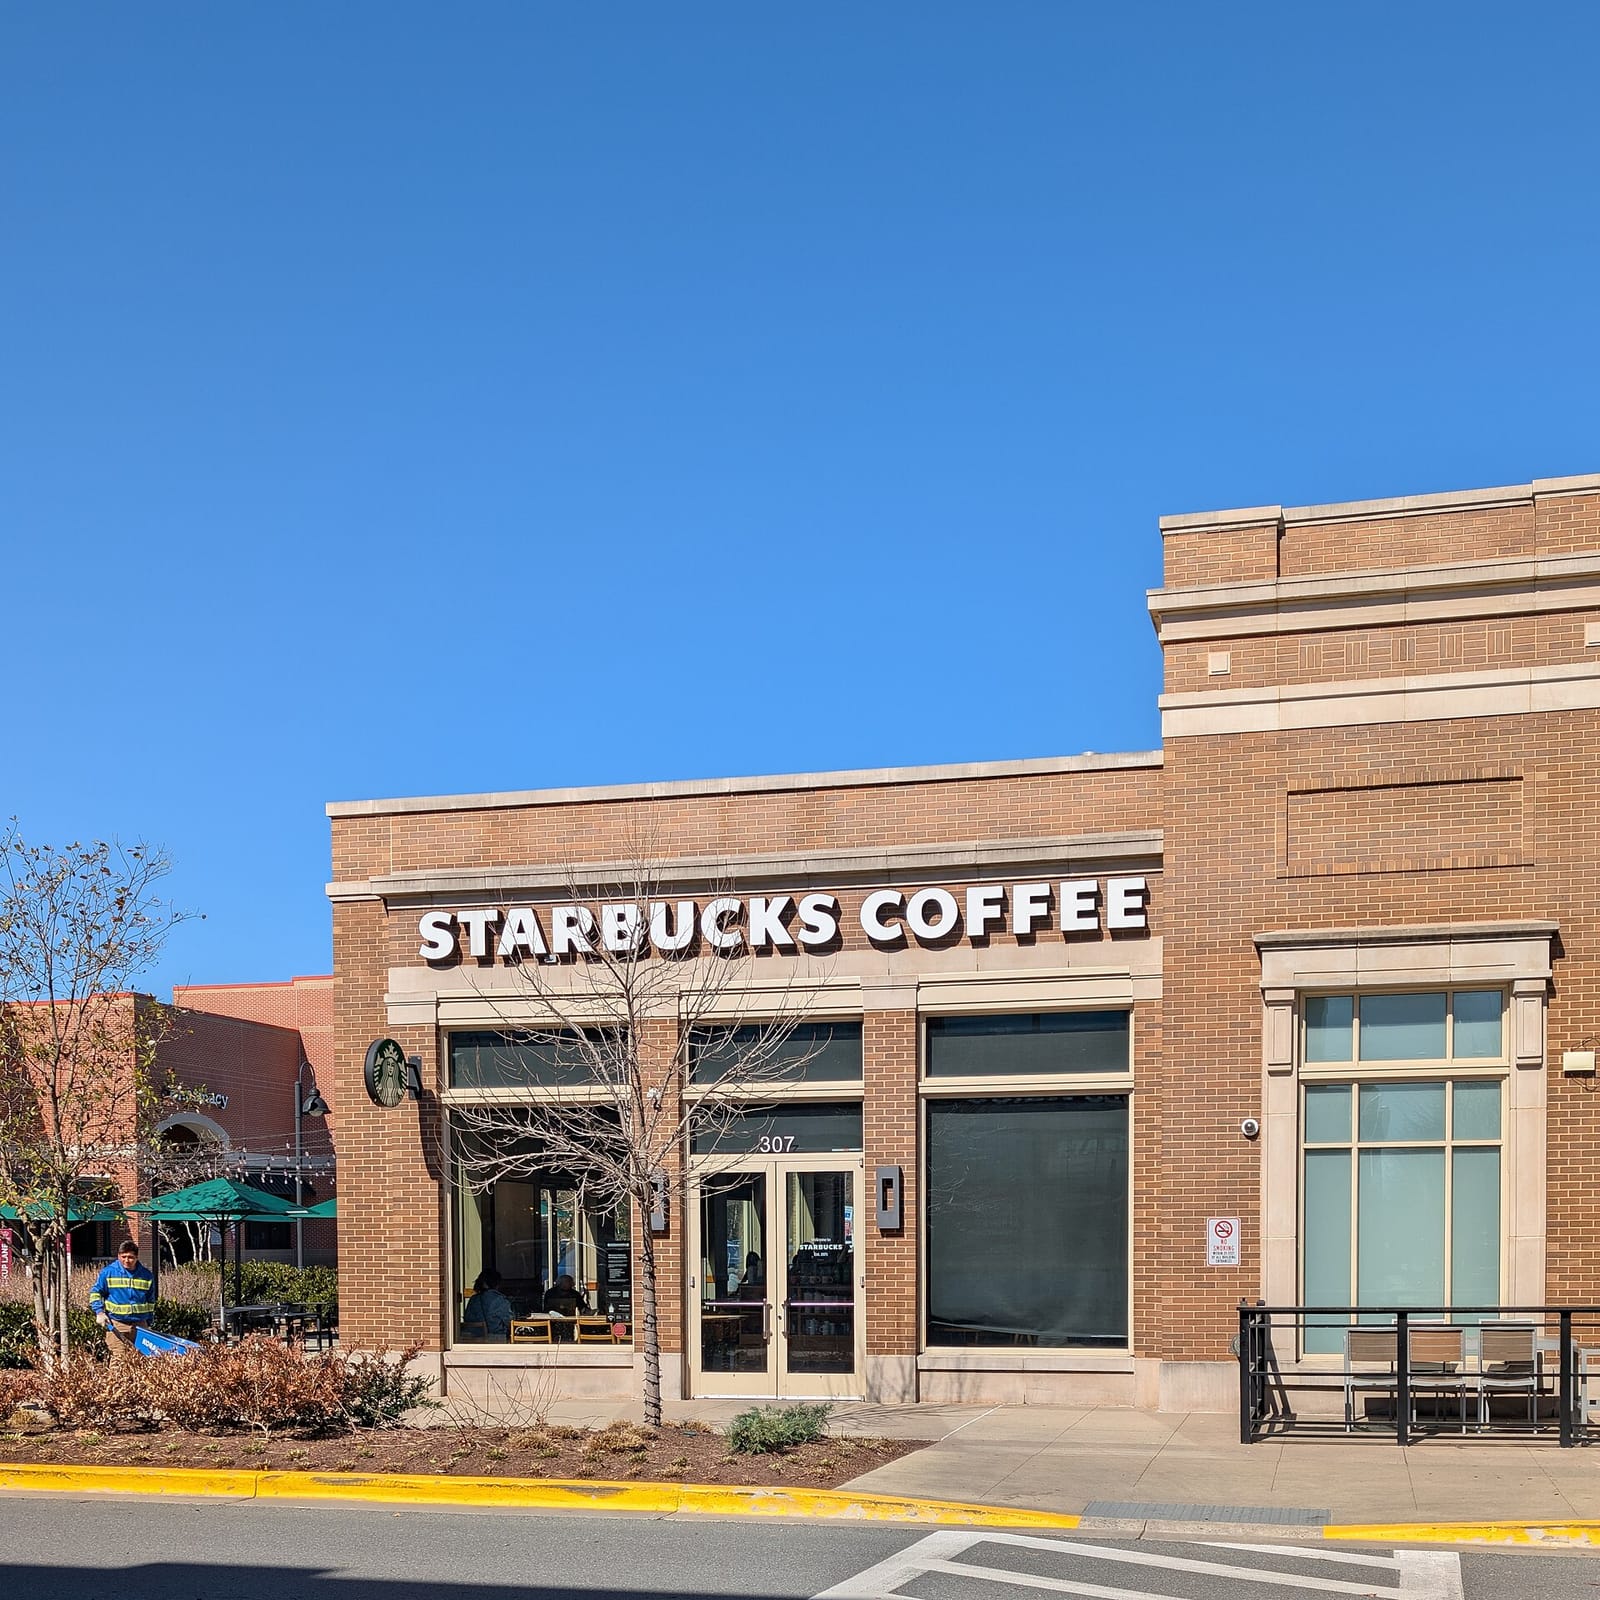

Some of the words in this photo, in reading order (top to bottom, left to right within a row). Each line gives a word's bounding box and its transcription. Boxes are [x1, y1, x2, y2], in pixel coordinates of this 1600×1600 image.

[418, 893, 836, 960] STARBUCKS
[860, 876, 1147, 941] COFFEE
[760, 1136, 795, 1153] 307
